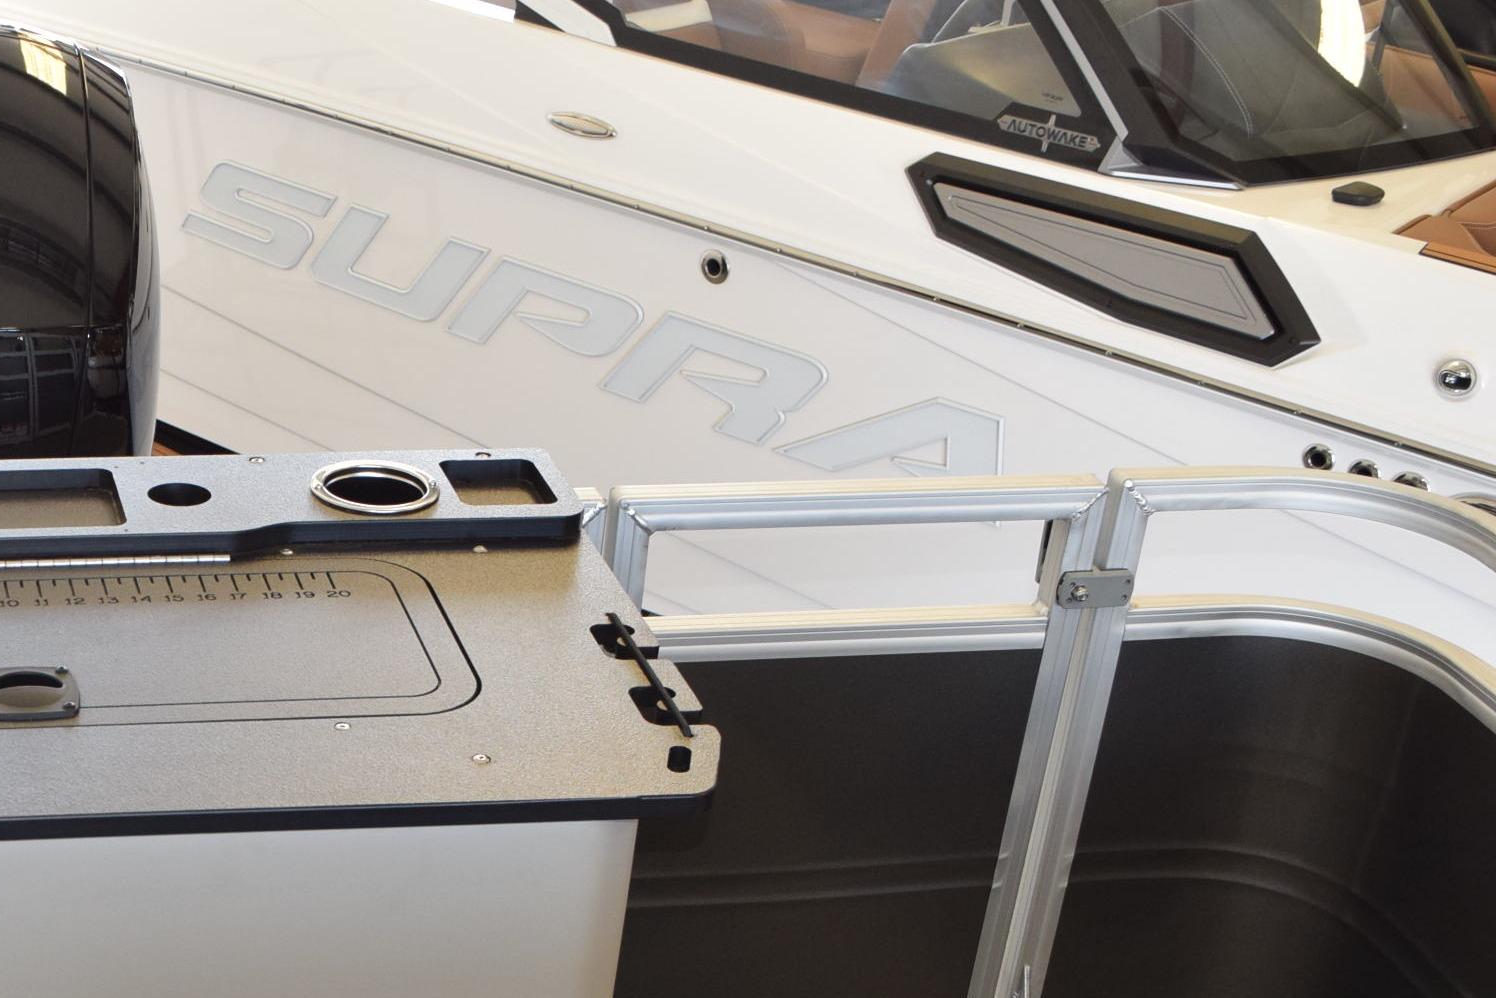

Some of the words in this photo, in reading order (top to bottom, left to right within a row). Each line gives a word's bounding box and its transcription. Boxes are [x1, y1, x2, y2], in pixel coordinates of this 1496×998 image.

[1007, 119, 1088, 148] AUTOWAKE
[181, 160, 1004, 478] SUPRA
[0, 599, 20, 607] 10
[34, 598, 49, 607] 11
[64, 597, 87, 606] 12
[97, 596, 120, 605] 13
[130, 595, 152, 604] 14
[165, 594, 185, 603] 15
[196, 592, 217, 601] 16
[229, 592, 247, 601] 17
[261, 591, 283, 600] 18
[295, 590, 316, 599] 19
[326, 589, 352, 599] 20
